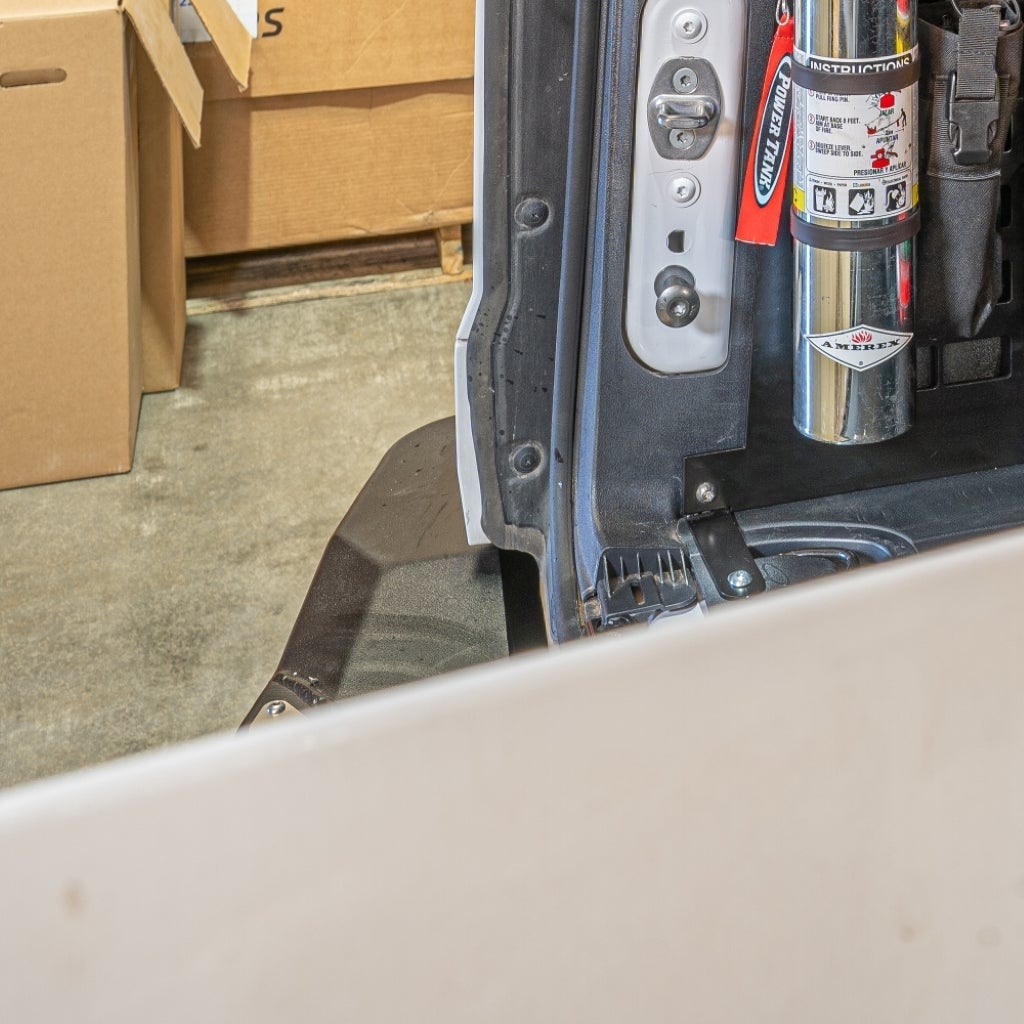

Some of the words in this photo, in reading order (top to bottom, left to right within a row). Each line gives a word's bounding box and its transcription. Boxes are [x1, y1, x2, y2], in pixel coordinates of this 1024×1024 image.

[769, 71, 791, 137] POWER
[759, 138, 780, 190] TANK
[821, 338, 900, 351] AMEREX
